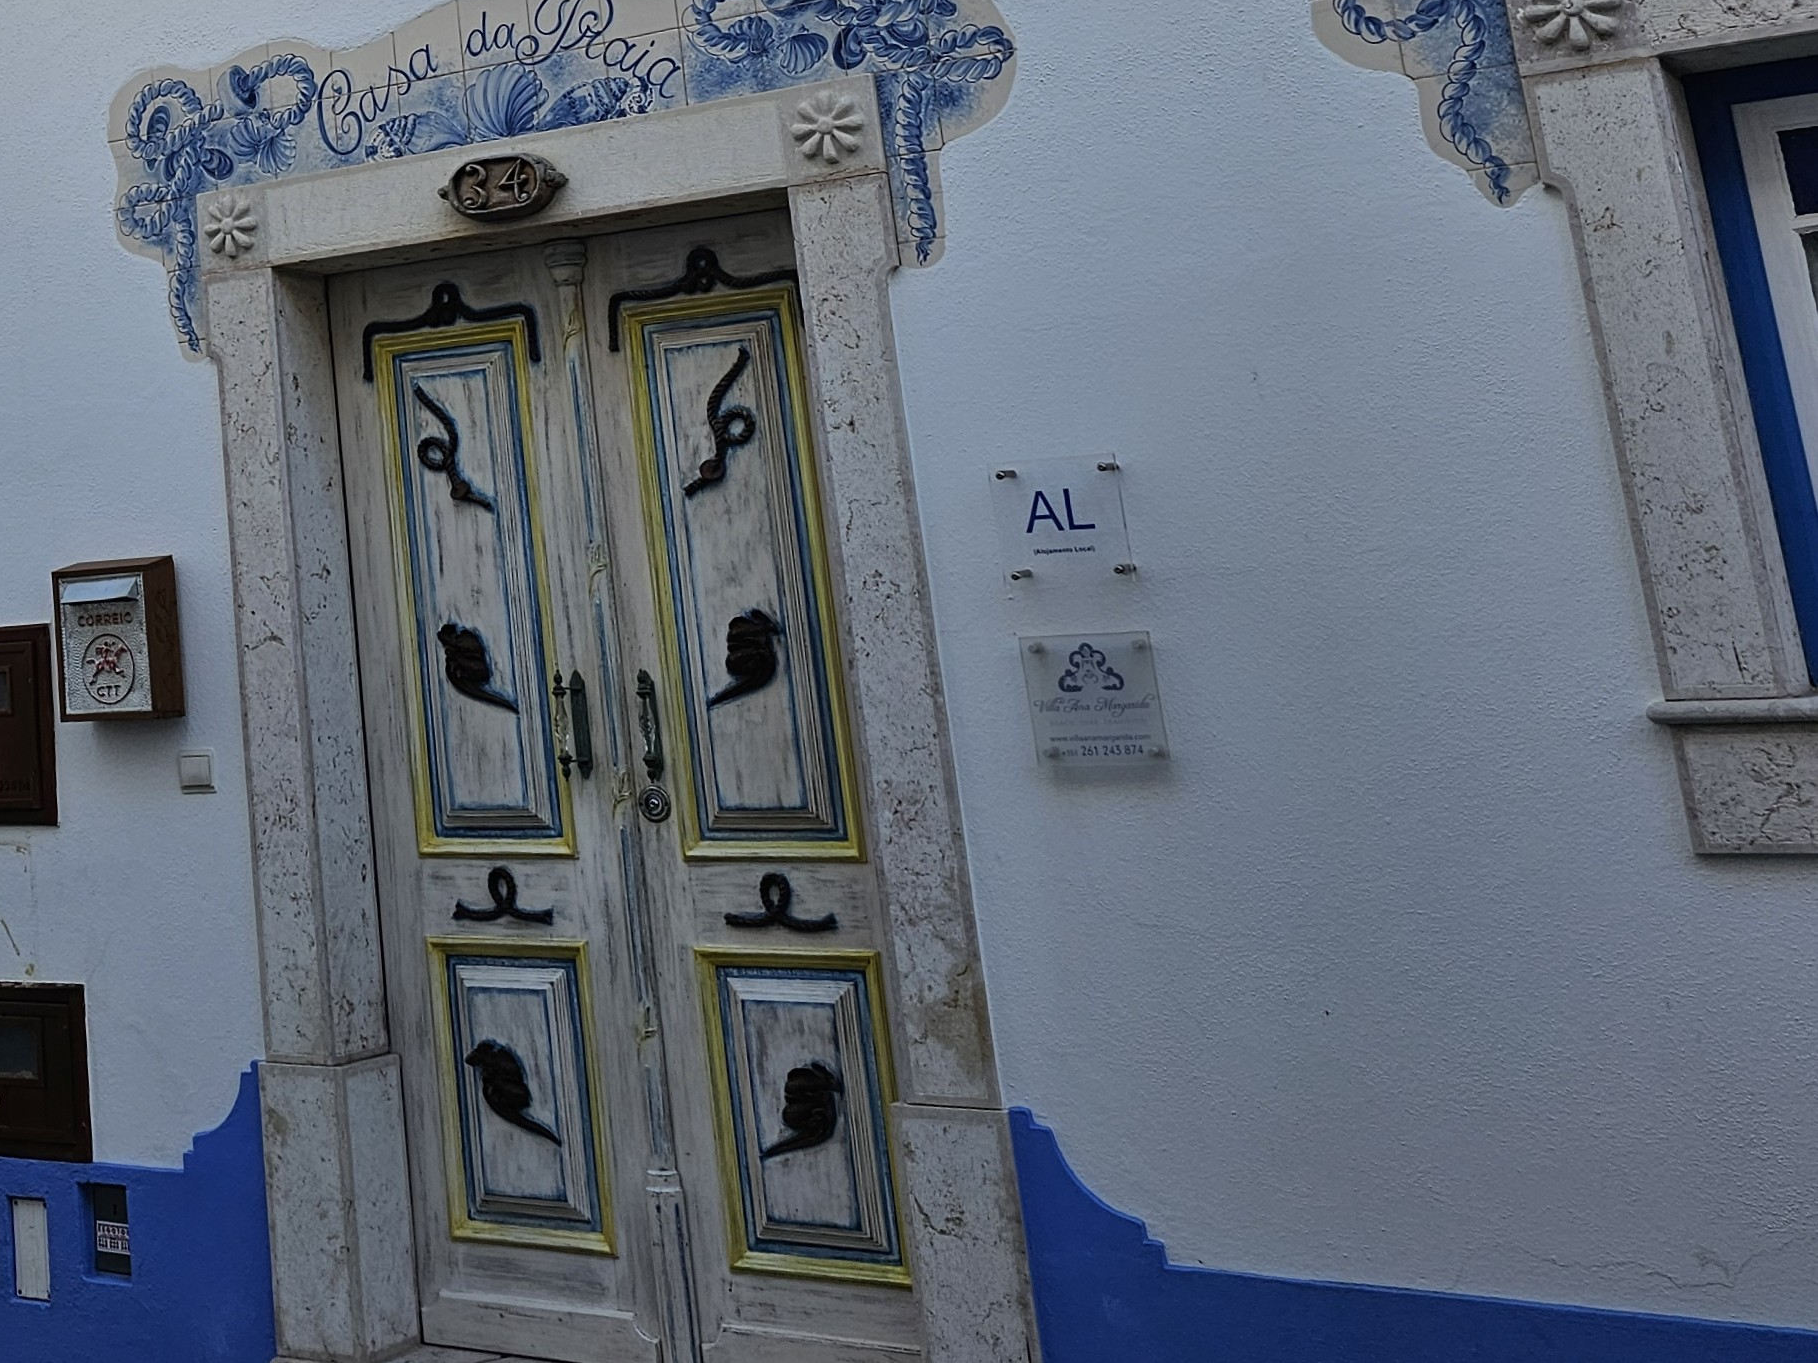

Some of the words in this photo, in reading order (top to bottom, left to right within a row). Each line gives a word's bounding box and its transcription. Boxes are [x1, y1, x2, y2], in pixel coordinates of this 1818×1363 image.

[317, 43, 438, 155] Casa
[464, 11, 517, 58] da
[463, 158, 528, 209] 34
[1026, 488, 1096, 533] AL
[77, 611, 134, 627] CORREIO
[96, 684, 121, 698] CTT
[1080, 745, 1099, 756] 261
[1102, 744, 1122, 756] 243
[1124, 744, 1144, 755] 874
